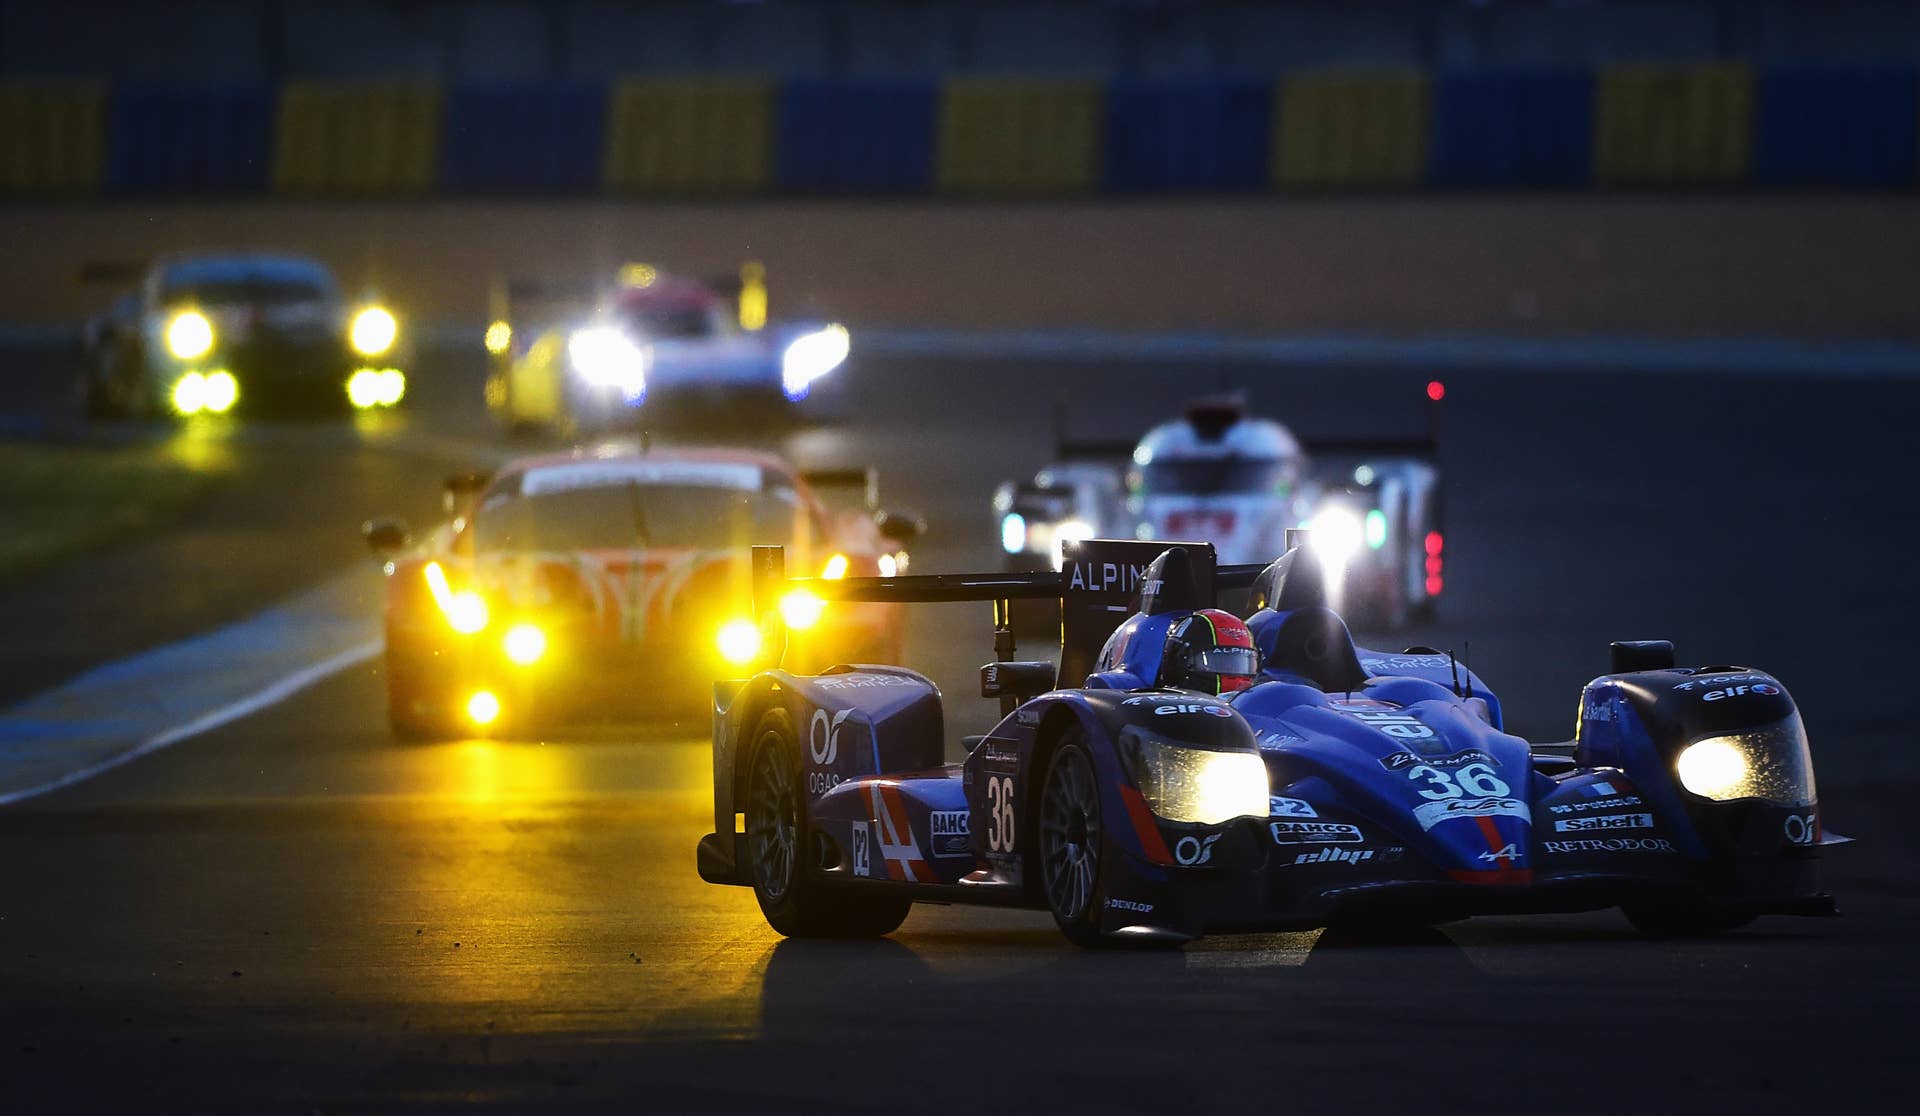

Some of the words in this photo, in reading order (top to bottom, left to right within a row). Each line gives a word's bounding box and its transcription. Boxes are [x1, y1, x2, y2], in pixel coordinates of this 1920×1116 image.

[1408, 762, 1511, 801] 36
[933, 813, 968, 832] BAHC
[988, 776, 1015, 853] 36
[1566, 815, 1643, 829] Sabelt
[1277, 823, 1353, 832] BAHCO
[854, 828, 869, 868] P2
[1544, 839, 1681, 853] RETRODOR
[1111, 898, 1154, 912] DUNLOP
